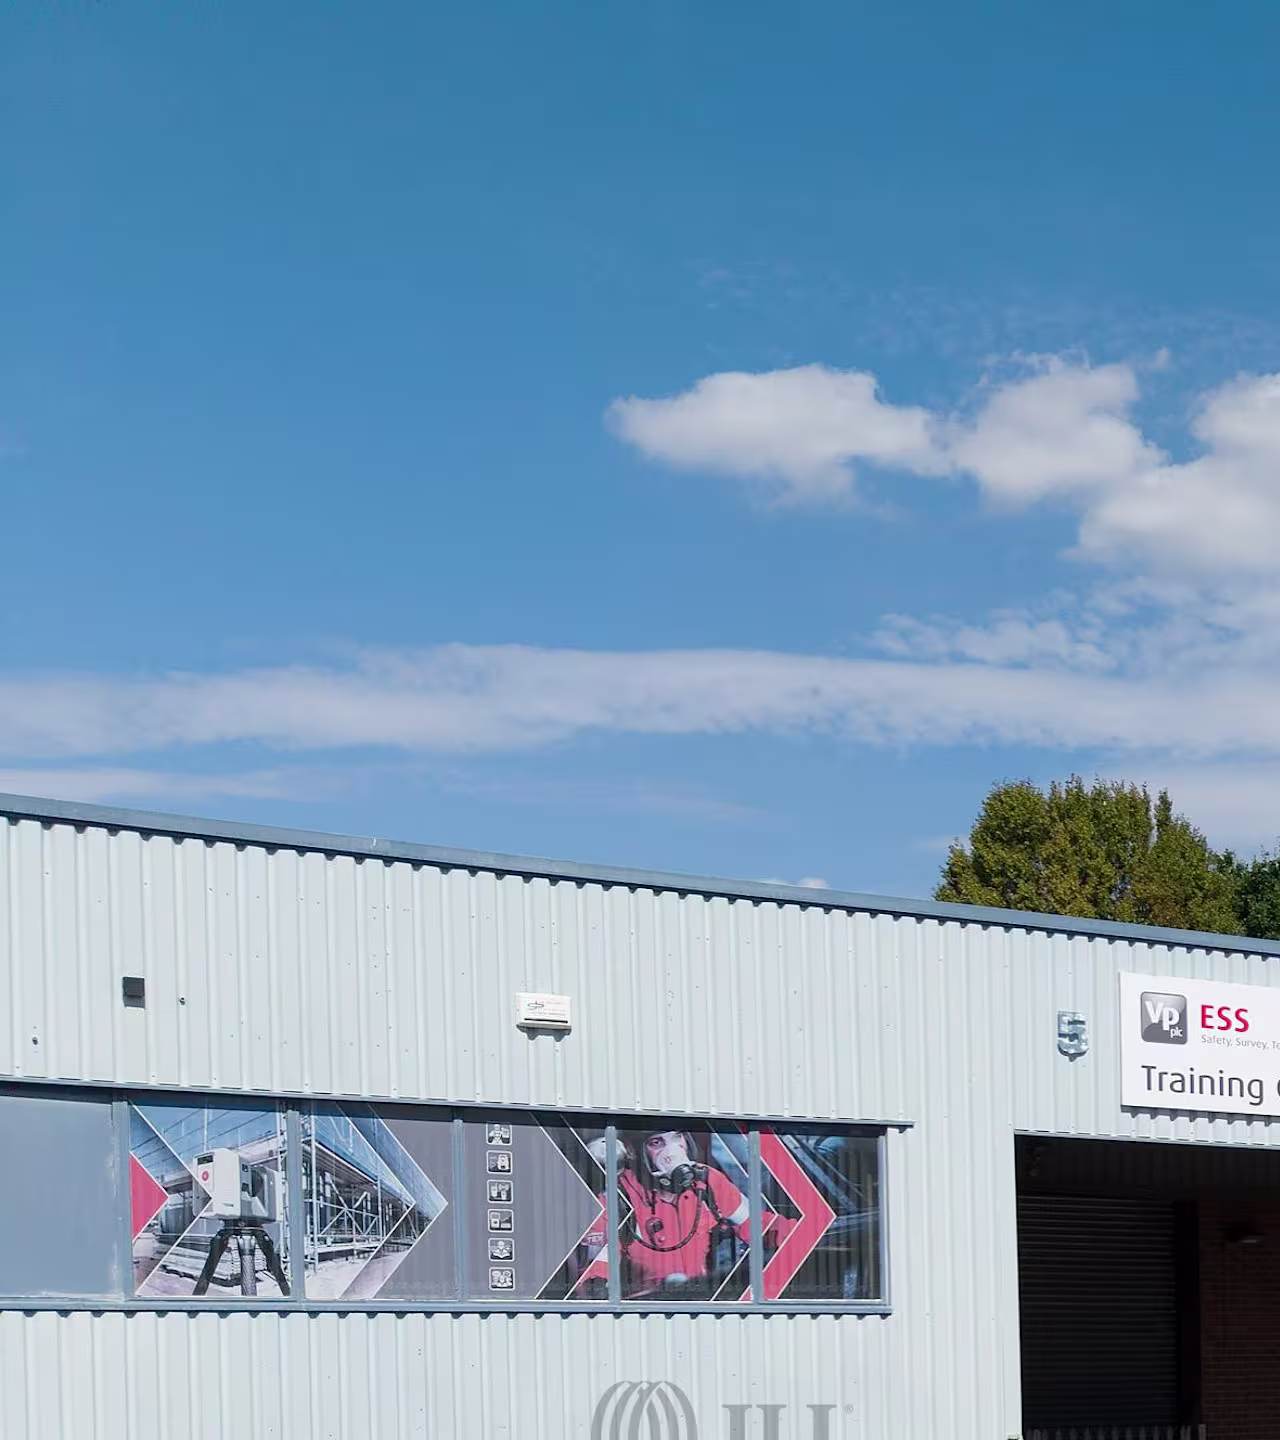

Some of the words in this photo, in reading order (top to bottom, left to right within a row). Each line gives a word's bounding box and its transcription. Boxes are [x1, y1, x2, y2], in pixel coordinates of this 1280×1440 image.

[1145, 1000, 1180, 1031] Vp
[1200, 1004, 1250, 1033] ESS
[1169, 1027, 1183, 1039] plc
[1201, 1034, 1233, 1047] Safety,
[1235, 1037, 1269, 1050] Survey,
[1141, 1065, 1264, 1106] Training
